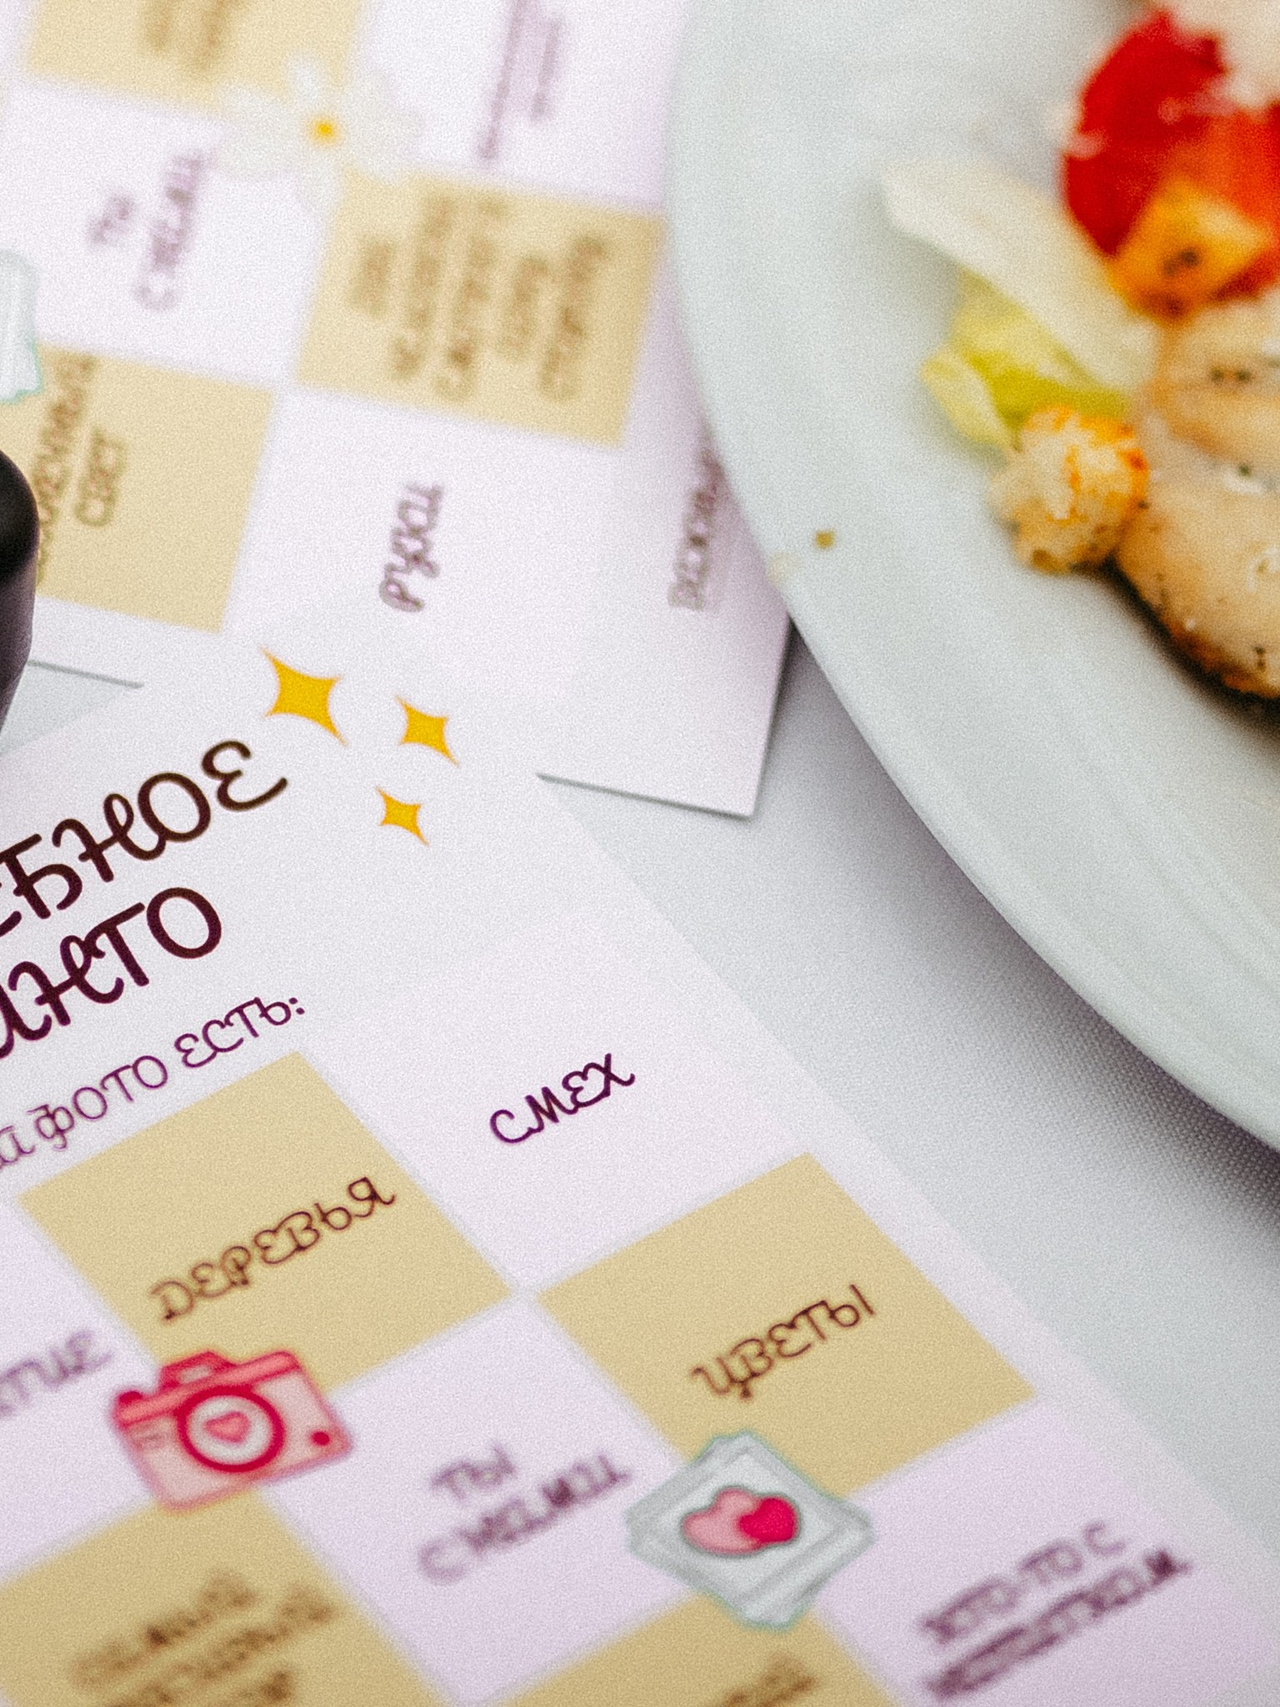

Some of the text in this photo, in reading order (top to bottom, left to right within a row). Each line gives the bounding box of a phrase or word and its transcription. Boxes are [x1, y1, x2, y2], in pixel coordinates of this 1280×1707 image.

[29, 1054, 170, 1151] ФОТО
[172, 995, 306, 1071] ЕСТЬ:
[488, 1052, 637, 1146] СМЕХ
[149, 1175, 397, 1325] ДЕРЕВЬЯ
[689, 1283, 877, 1403] ЦВЕТЫ
